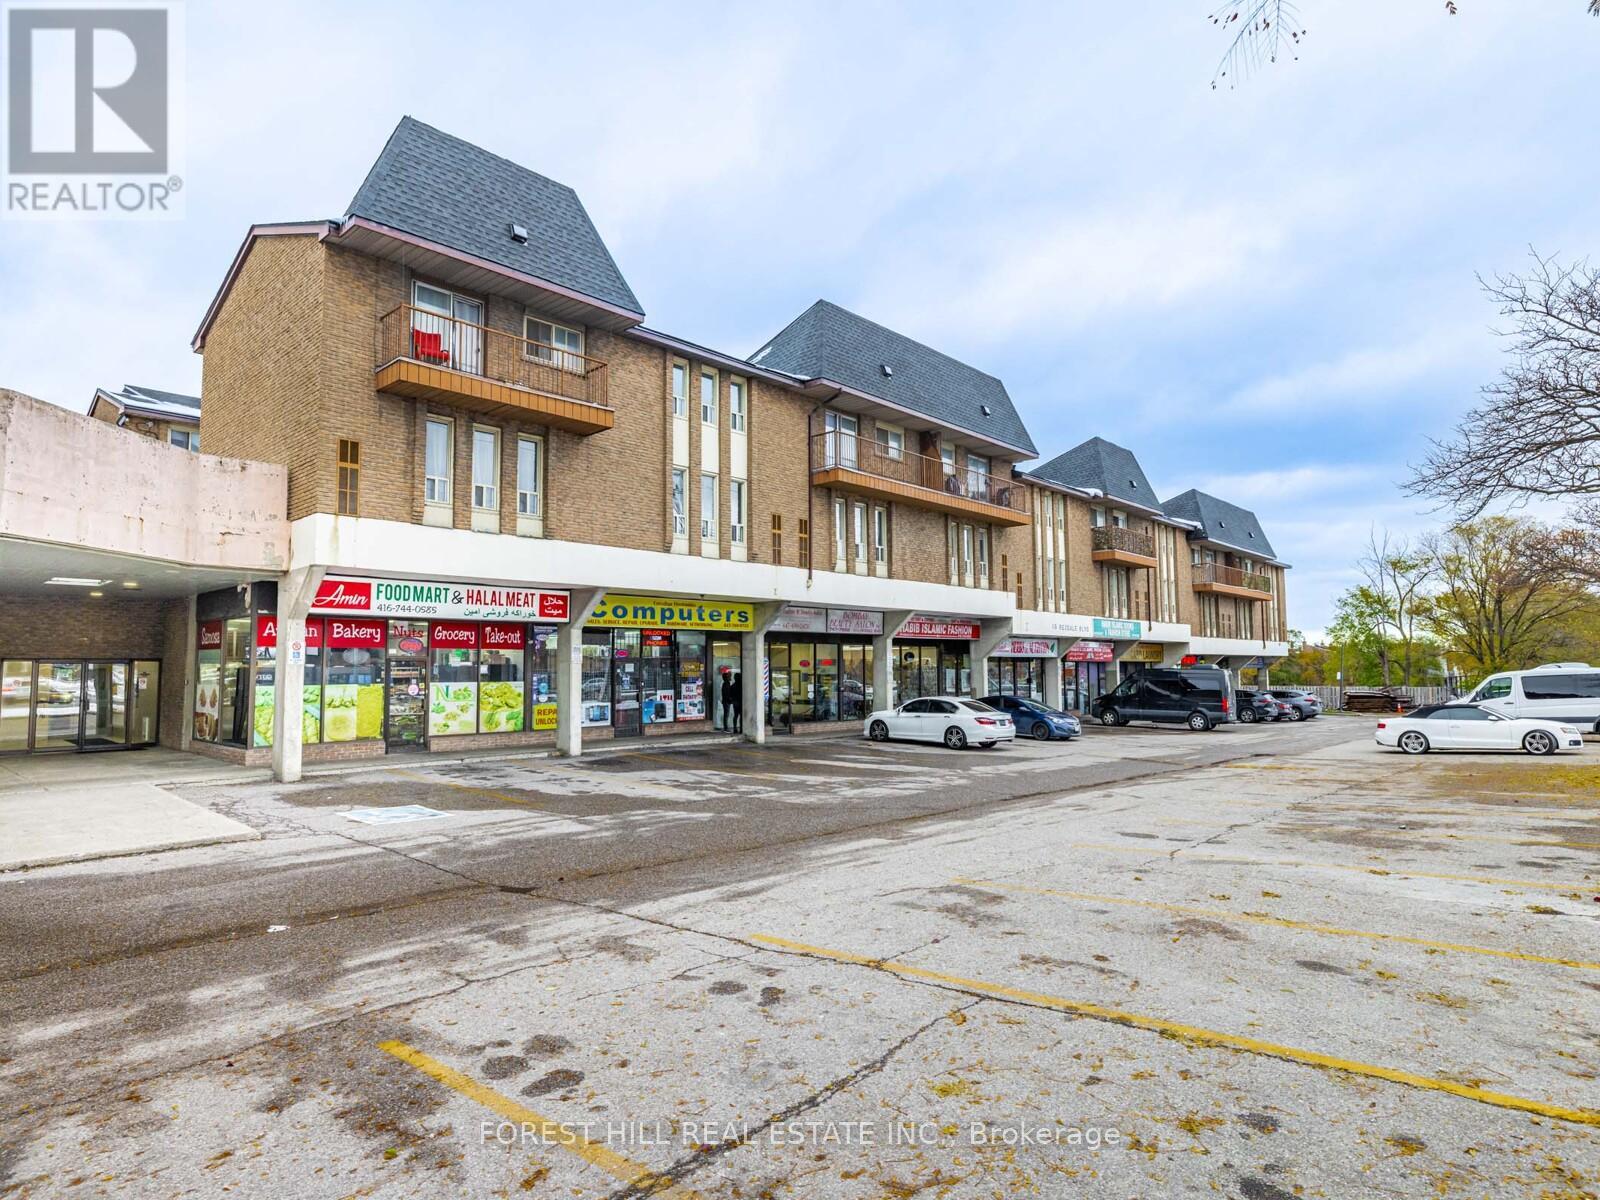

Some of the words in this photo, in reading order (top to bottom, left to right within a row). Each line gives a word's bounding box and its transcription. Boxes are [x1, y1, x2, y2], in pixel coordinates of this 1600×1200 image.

[313, 584, 369, 606] Amin
[451, 590, 464, 604] &
[466, 589, 504, 606] HALAL
[505, 591, 536, 608] MEAT
[591, 600, 750, 626] Computers
[332, 623, 381, 642] Bakery
[434, 626, 475, 644] Grocery
[485, 626, 521, 644] Take-out
[921, 622, 947, 634] ISLAMIC
[947, 624, 973, 635] FASHION
